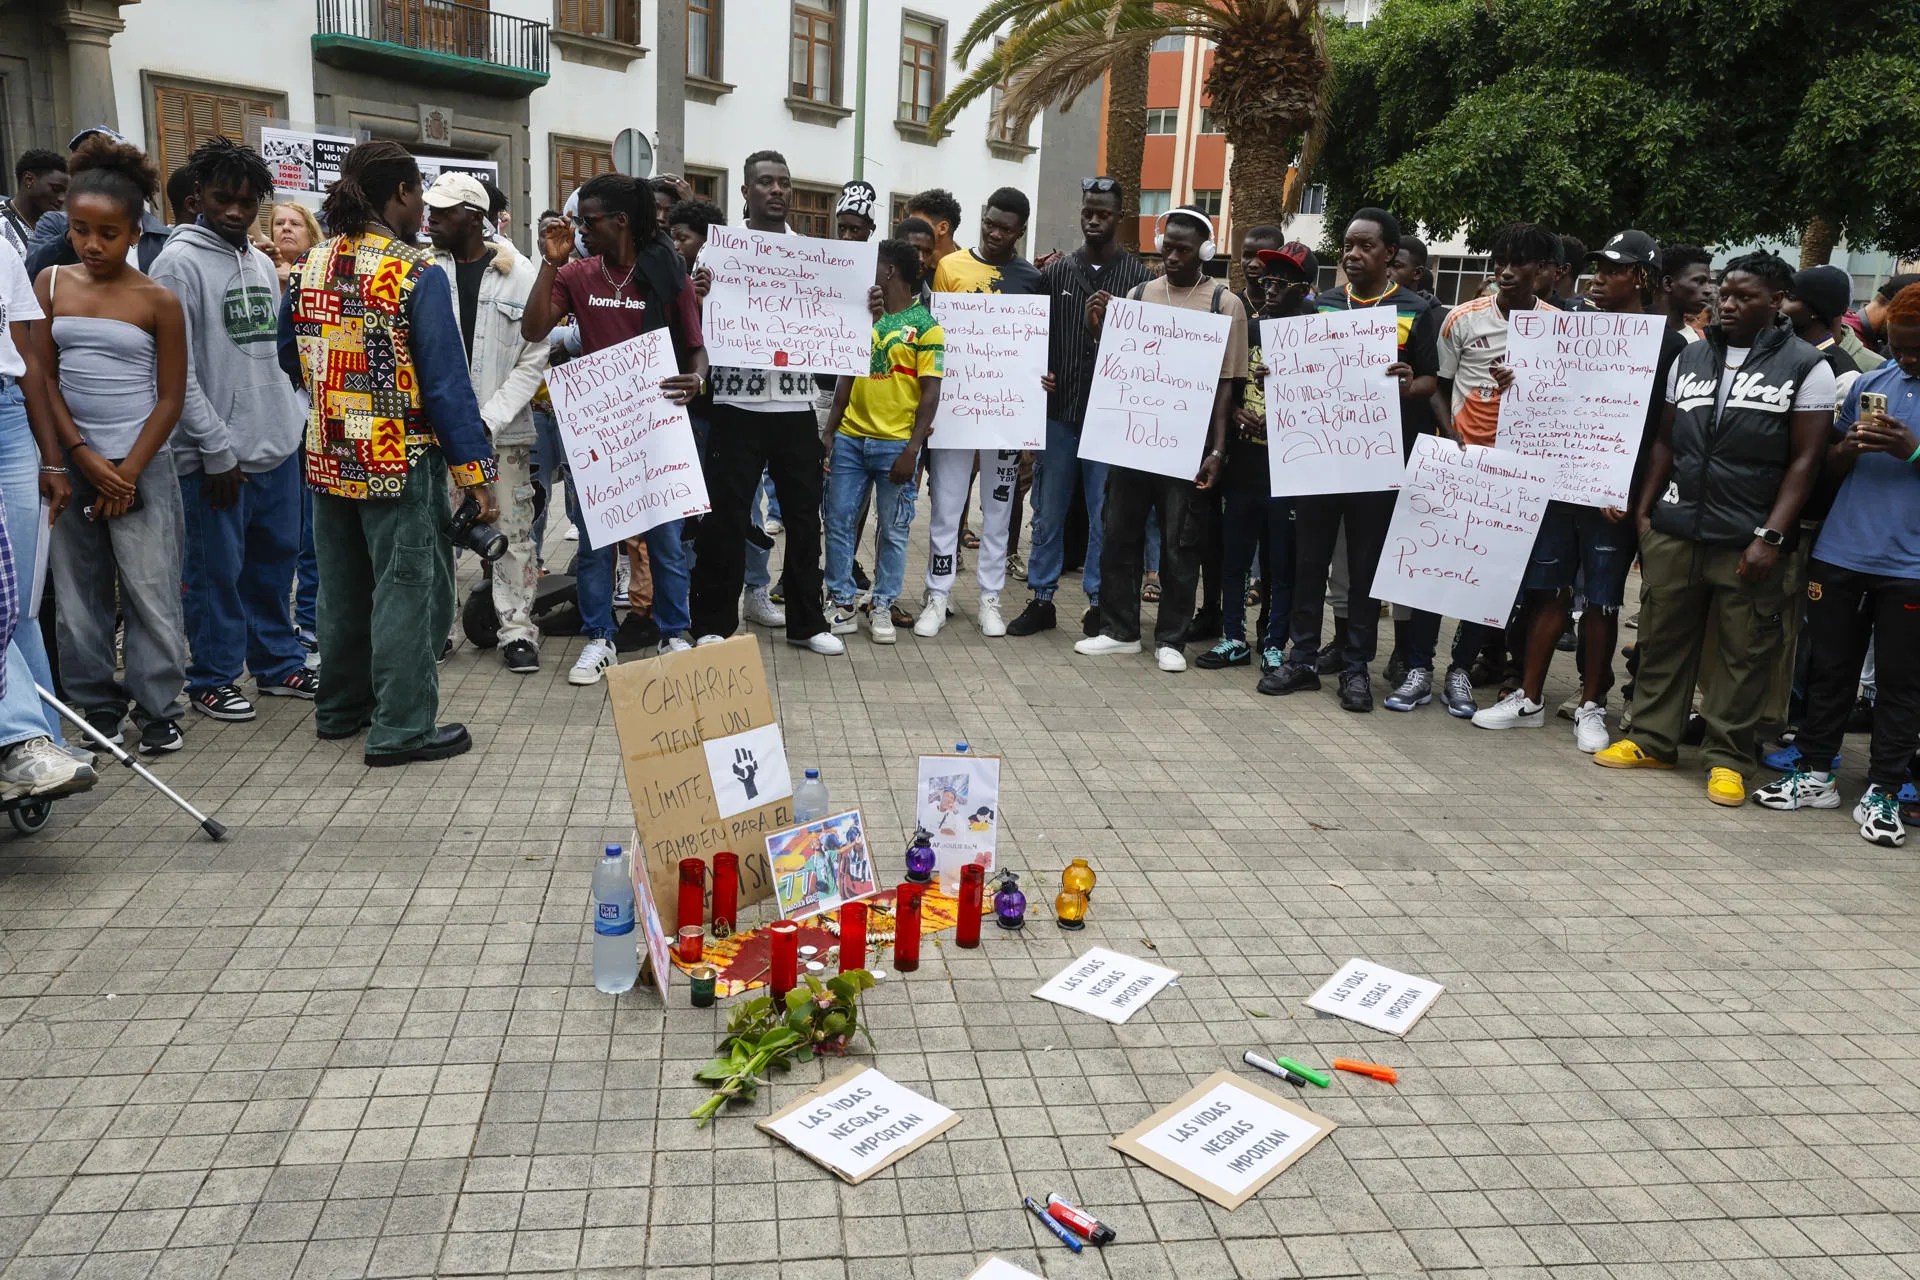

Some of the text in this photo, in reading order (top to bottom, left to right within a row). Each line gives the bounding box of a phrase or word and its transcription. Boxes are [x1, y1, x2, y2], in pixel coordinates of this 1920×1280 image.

[317, 144, 350, 154] QUE NO
[324, 154, 341, 162] NOS
[278, 164, 302, 173] TODOS
[279, 172, 302, 180] SOMOS
[316, 162, 340, 171] DIVID
[710, 225, 748, 250] Dicen
[229, 302, 267, 320] Huley
[951, 298, 995, 313] muerte
[1153, 316, 1201, 341] mataron
[1552, 314, 1649, 338] INJUSTICIA
[783, 337, 825, 351] error
[830, 339, 854, 357] fue
[944, 344, 961, 353] on
[1574, 338, 1631, 358] COLOR
[564, 349, 662, 408] ABDOULAYE
[944, 367, 959, 377] on
[1131, 360, 1192, 389] mataron
[1674, 372, 1794, 412] New York
[1420, 521, 1488, 556] Sino
[1392, 537, 1481, 587] Presente
[641, 666, 754, 714] CANARIAS
[651, 707, 751, 757] TIENE UN
[732, 812, 771, 841] PARA
[775, 806, 792, 827] EL
[1059, 959, 1106, 992] LAS VIDAS
[1086, 970, 1126, 997] NEGRAS
[1329, 970, 1369, 1002] LAS VIDAS
[1110, 974, 1155, 1008] IMPORTAN
[1358, 982, 1392, 1009] NEGRAS
[1384, 988, 1422, 1020] IMPORTAN
[798, 1087, 873, 1130] LAS VIDAS
[828, 1104, 890, 1141] NEGRAS
[1167, 1100, 1232, 1143] LAS VIDAS
[850, 1113, 924, 1158] IMPORTAN
[1200, 1119, 1255, 1156] NEGRAS
[1226, 1129, 1291, 1174] IMPORTAN
